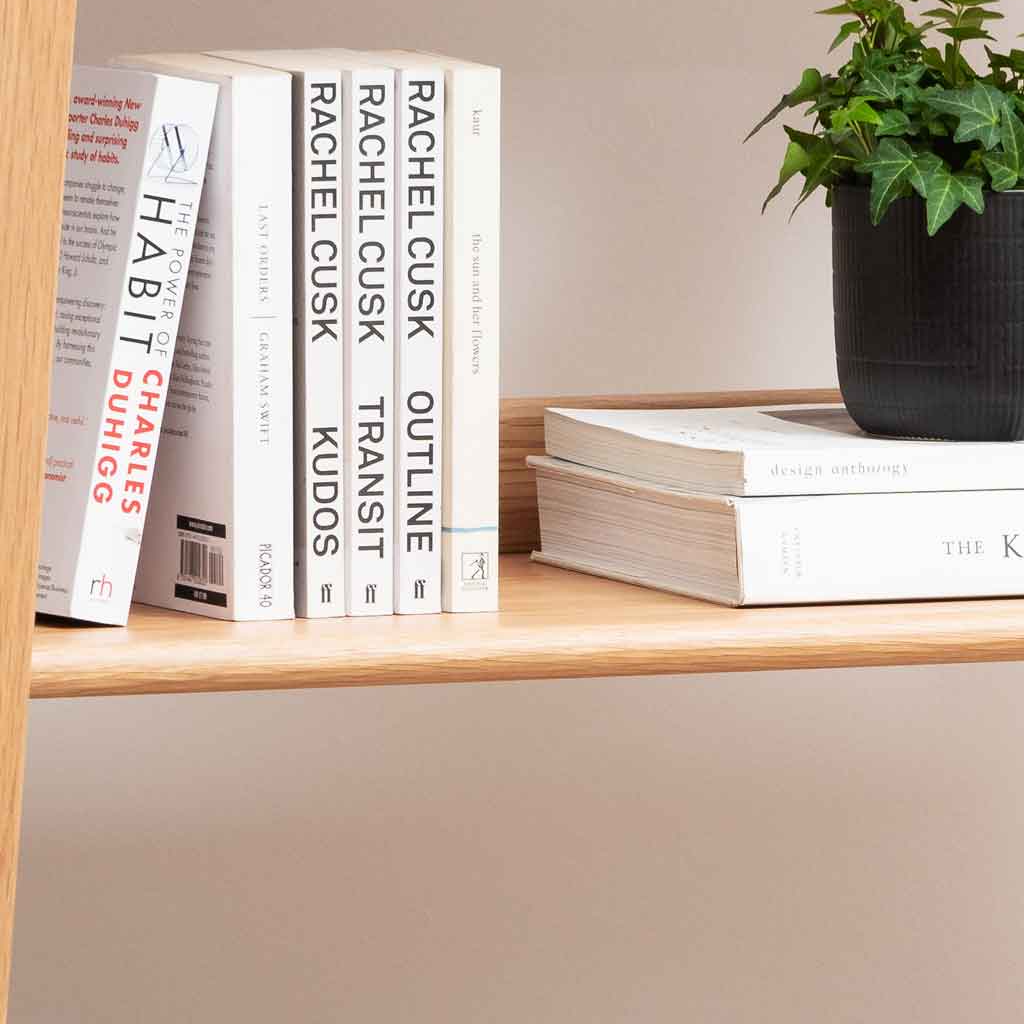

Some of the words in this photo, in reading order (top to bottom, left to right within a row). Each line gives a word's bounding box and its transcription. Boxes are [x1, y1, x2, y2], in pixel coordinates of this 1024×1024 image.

[90, 112, 113, 127] Charles
[114, 115, 139, 133] Duhigg
[123, 97, 144, 110] New
[472, 106, 483, 137] kaur
[71, 149, 88, 163] study
[89, 149, 98, 161] of
[81, 130, 95, 143] and
[95, 134, 128, 150] surprising
[310, 82, 338, 233] RACHEL
[358, 84, 386, 234] RACHEL
[408, 80, 436, 231] RACHEL
[174, 201, 193, 239] THE
[257, 205, 271, 238] LAST
[472, 234, 483, 252] the
[119, 193, 177, 354] HABIT
[160, 248, 185, 320] POWER
[257, 244, 271, 304] ORDERS
[472, 255, 481, 277] sun
[311, 240, 339, 343] CUSK
[358, 241, 386, 344] CUSK
[407, 237, 435, 340] CUSK
[472, 280, 483, 303] and
[472, 306, 483, 325] her
[155, 331, 171, 359] OF
[472, 329, 483, 375] flowers
[257, 332, 271, 397] GRAHAM
[93, 369, 133, 504] DUHIGG
[121, 369, 163, 514] CHARLES
[257, 401, 271, 445] SWIFT
[357, 396, 384, 559] TRANSIT
[406, 391, 434, 553] OUTLINE
[770, 463, 822, 479] design
[312, 426, 339, 558] KUDOS
[259, 544, 272, 589] PICADOR
[942, 540, 985, 556] THE
[89, 574, 113, 598] rh
[259, 594, 272, 608] 40
[321, 584, 333, 604] ff
[365, 584, 377, 604] ff
[414, 579, 426, 600] ff
